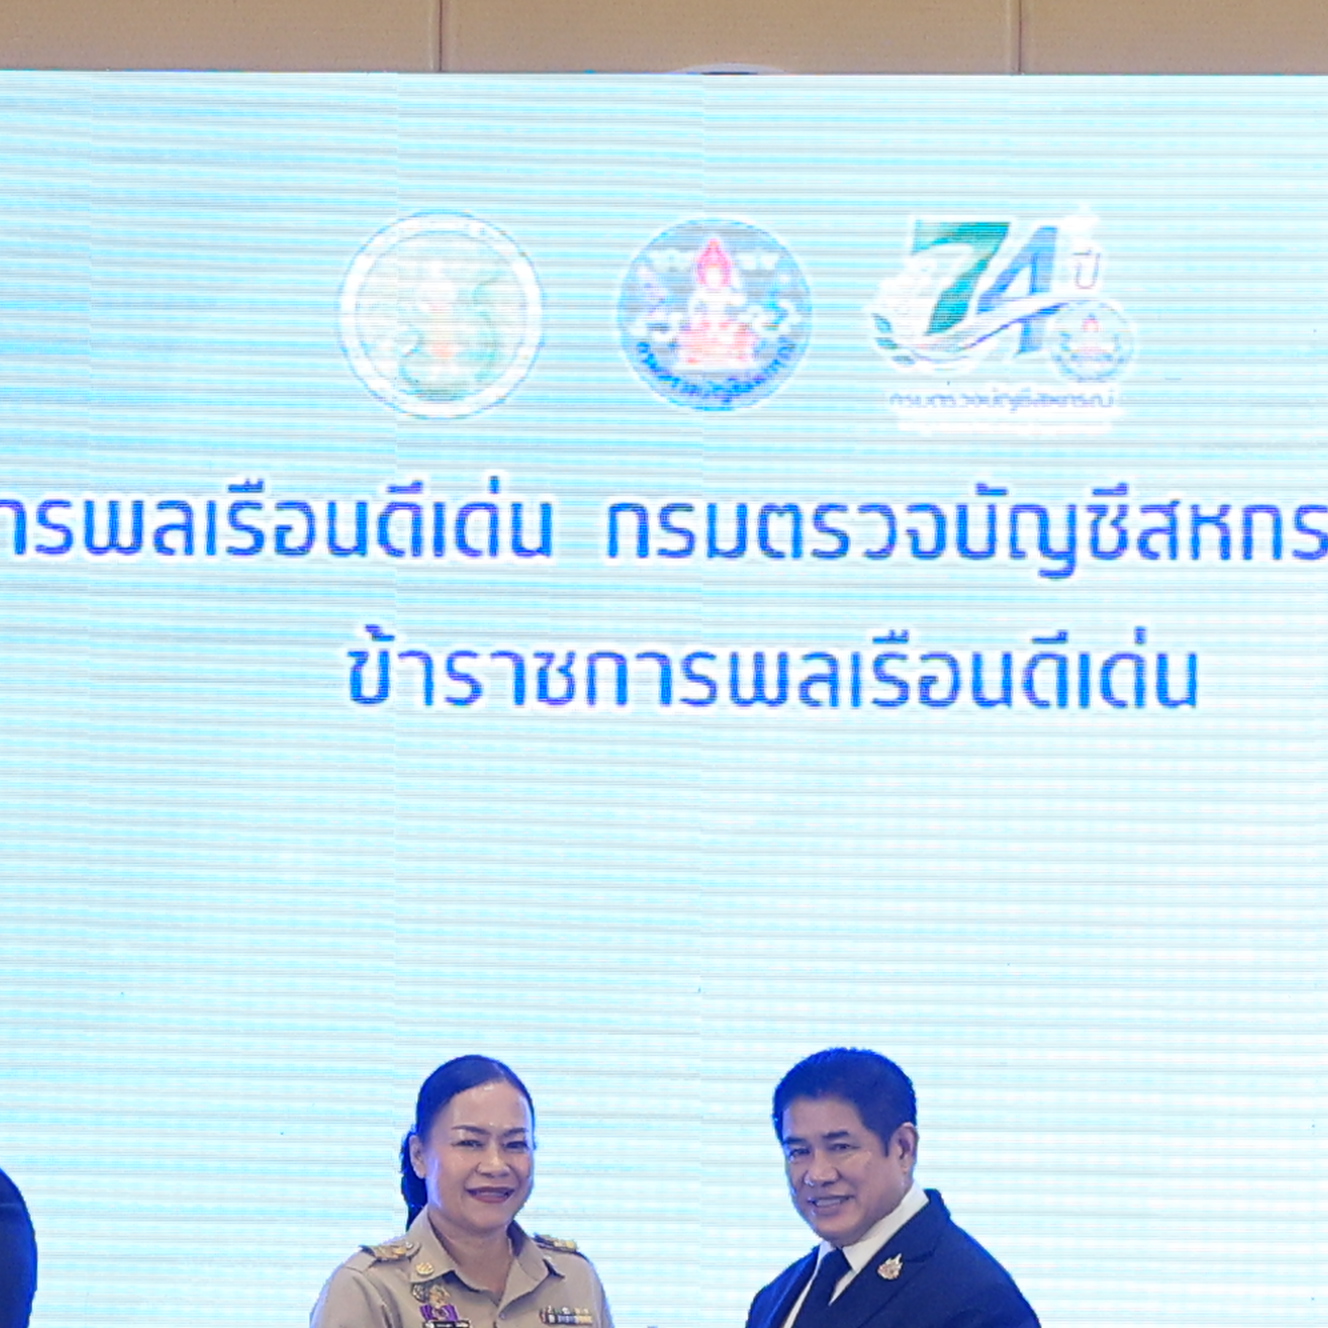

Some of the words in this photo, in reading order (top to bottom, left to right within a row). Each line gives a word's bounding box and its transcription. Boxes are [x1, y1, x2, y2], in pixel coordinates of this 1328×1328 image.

[348, 623, 1197, 710] ข้าราชการพลเรือนดีเด่น
